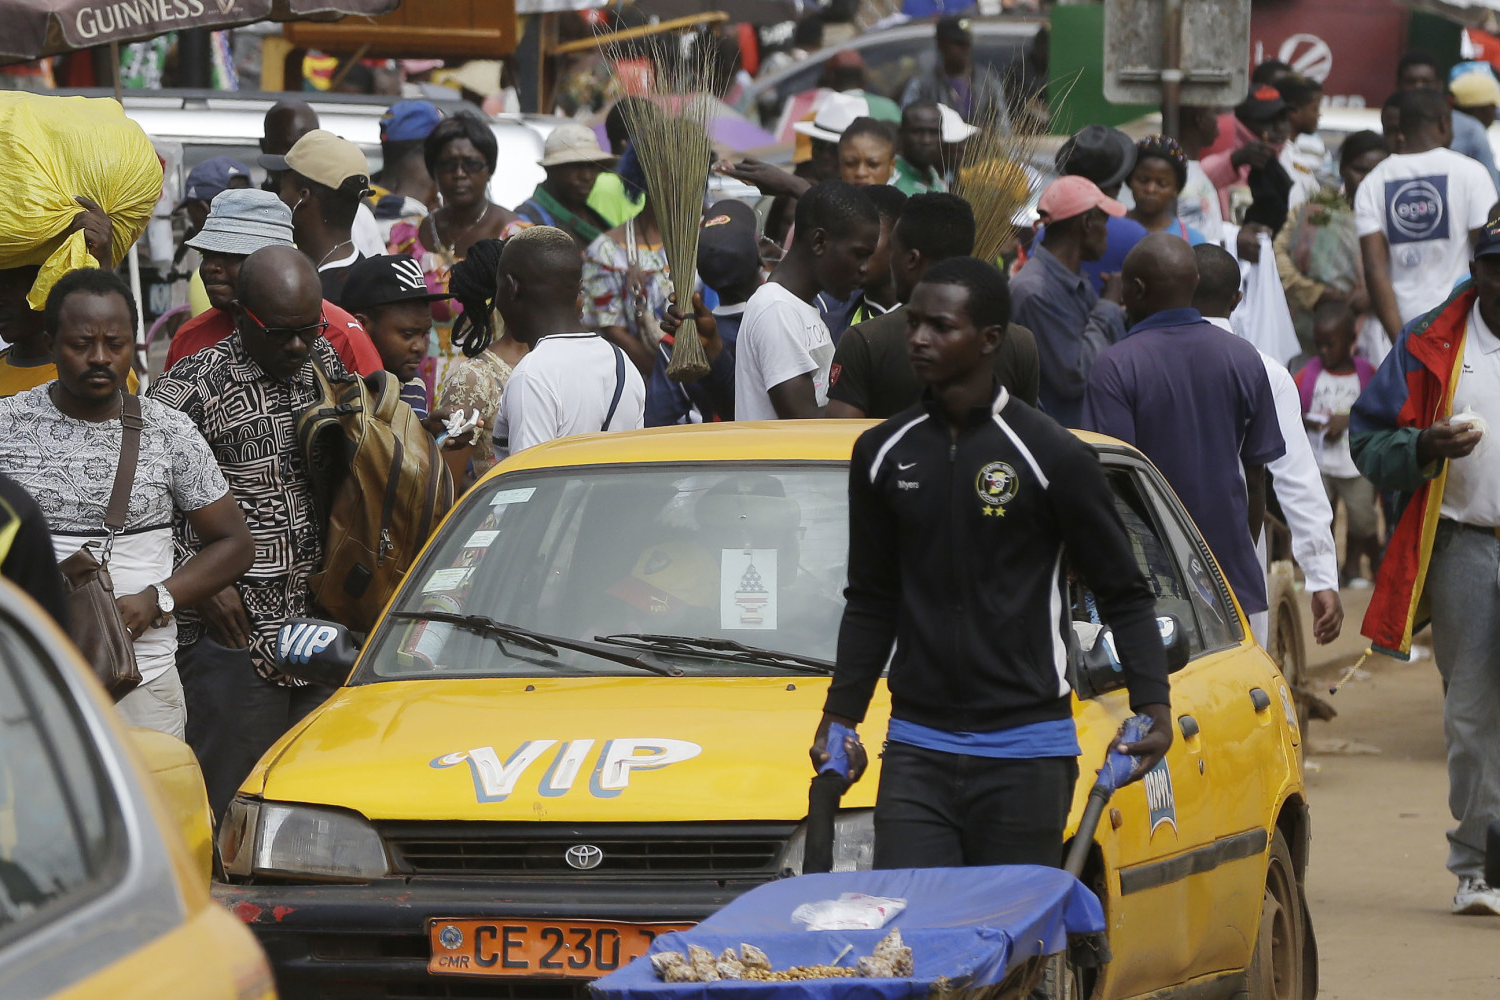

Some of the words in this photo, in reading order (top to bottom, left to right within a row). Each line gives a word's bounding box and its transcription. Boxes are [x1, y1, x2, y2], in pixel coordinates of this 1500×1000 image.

[898, 480, 919, 490] Myers
[278, 622, 338, 664] VIP
[429, 737, 703, 803] VIP
[438, 955, 470, 969] CMR
[474, 925, 528, 969] CE
[539, 928, 621, 971] 230
